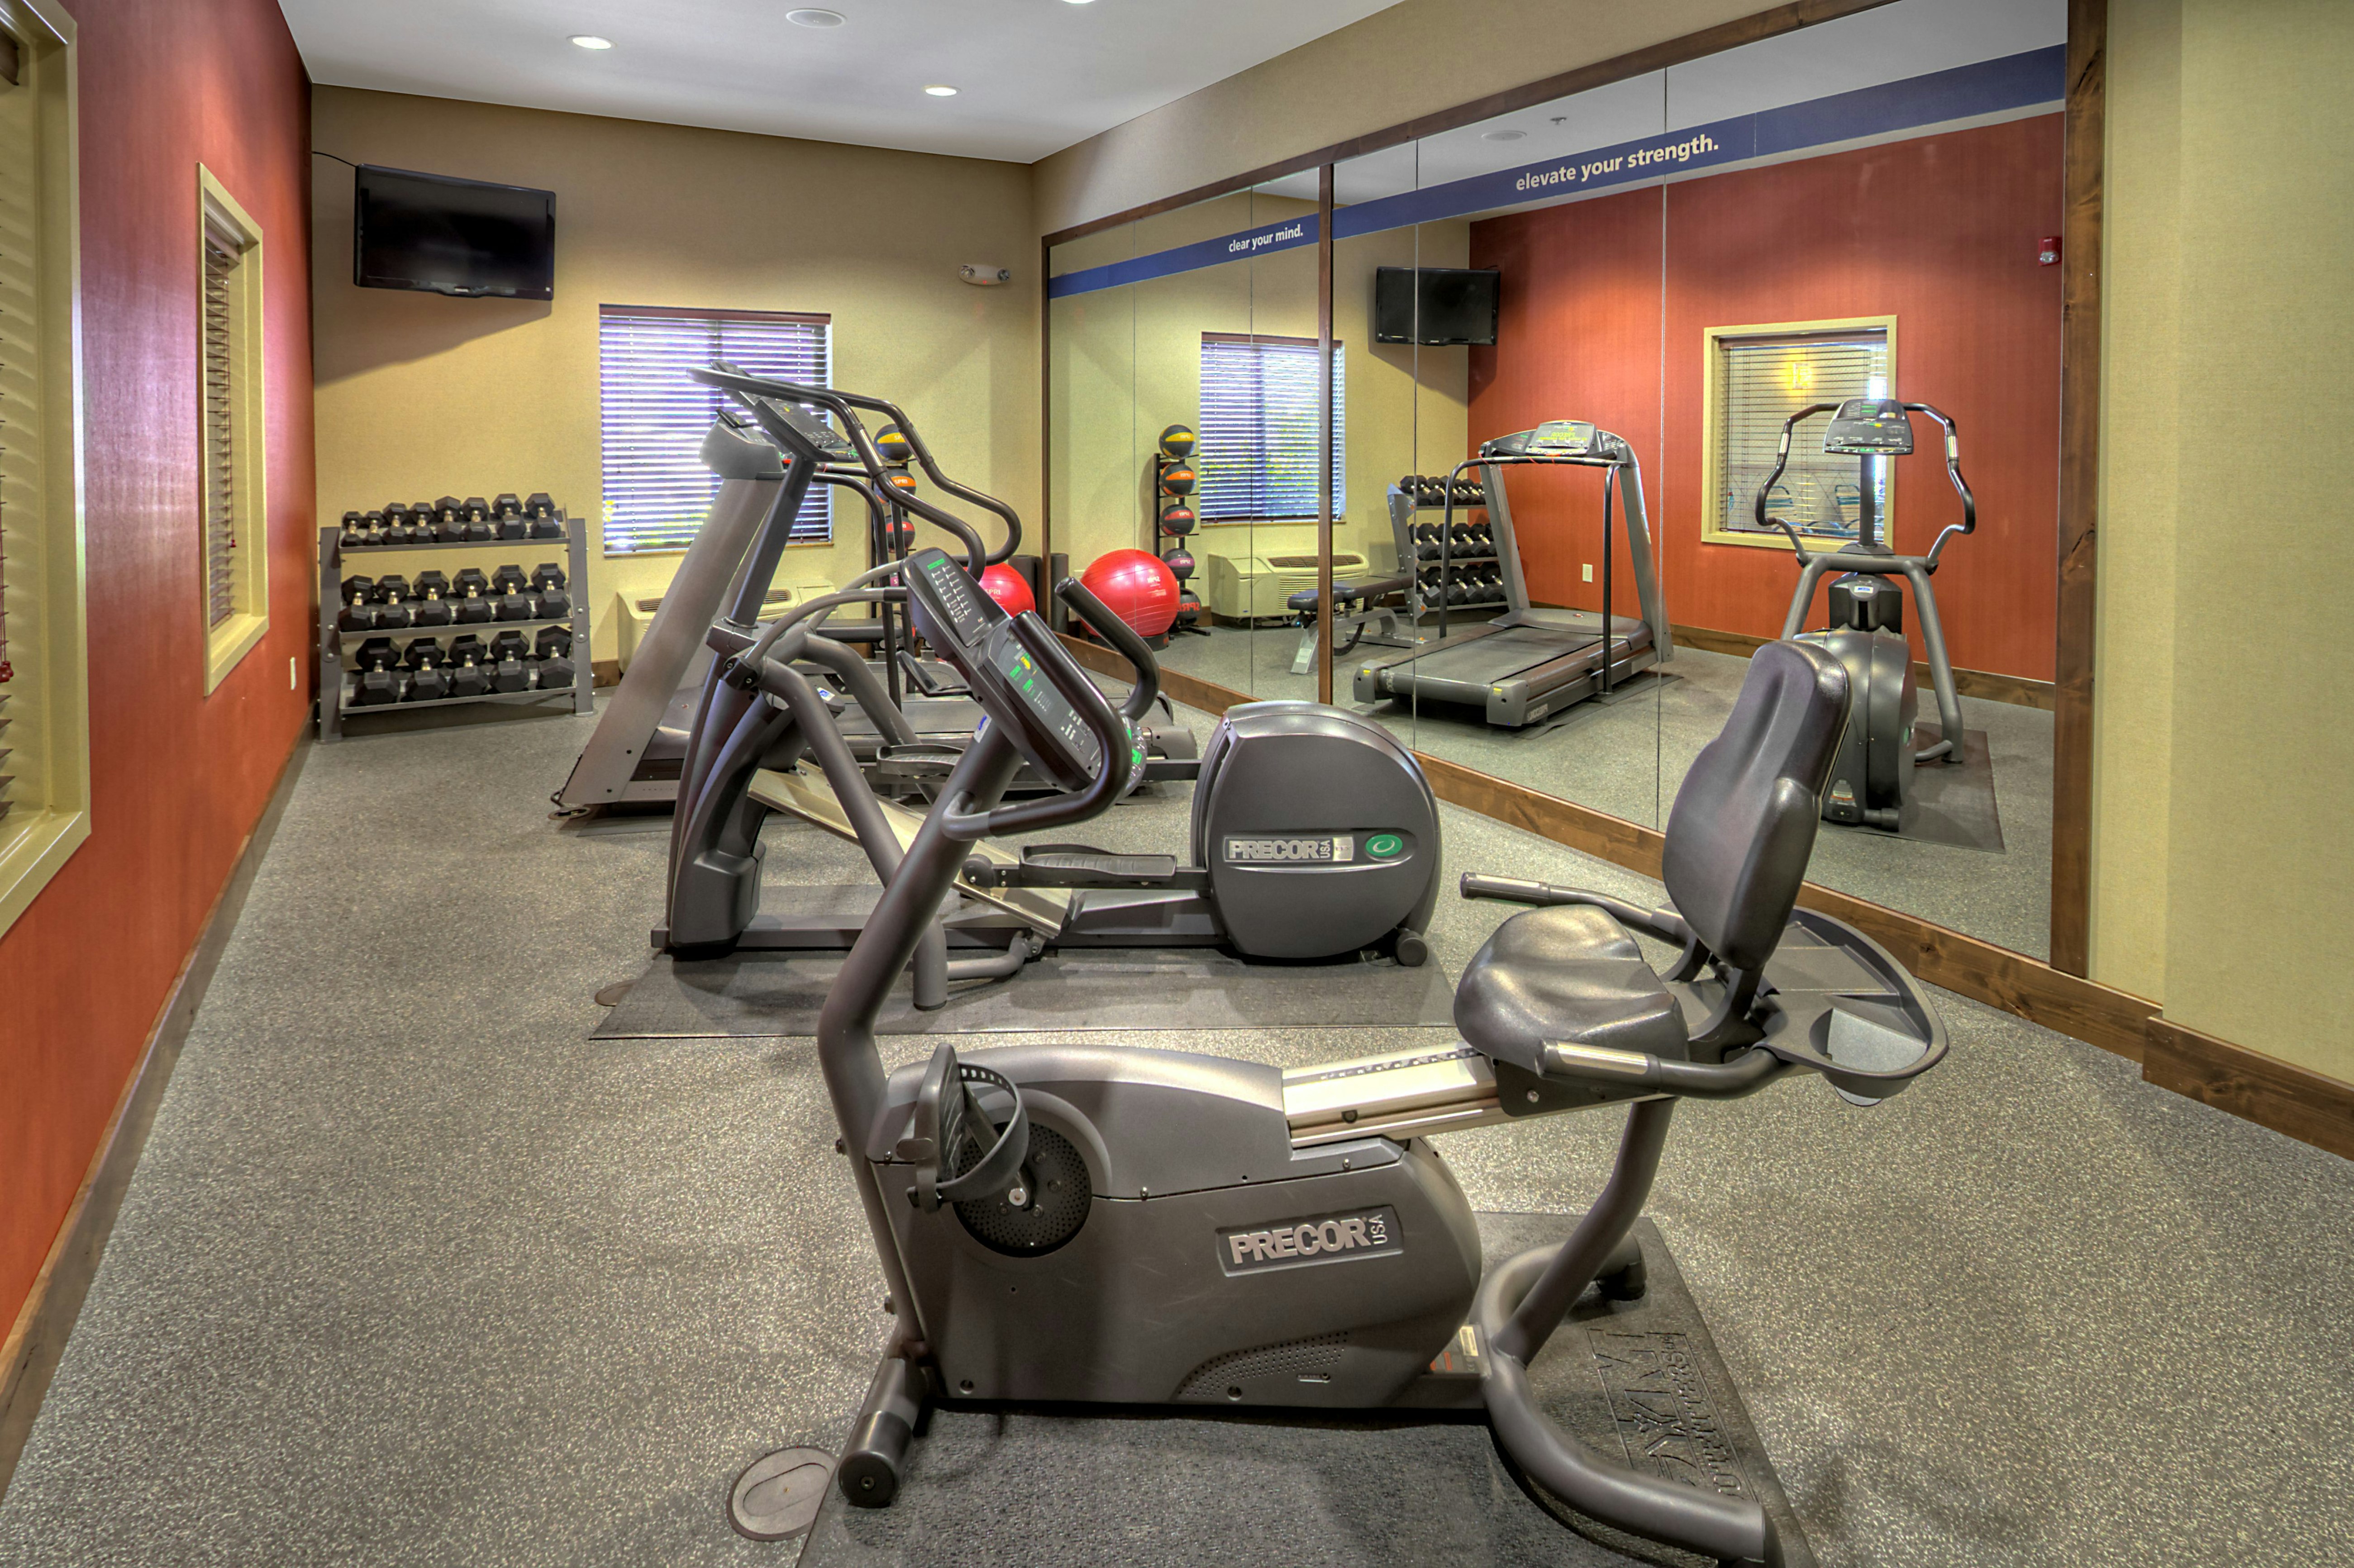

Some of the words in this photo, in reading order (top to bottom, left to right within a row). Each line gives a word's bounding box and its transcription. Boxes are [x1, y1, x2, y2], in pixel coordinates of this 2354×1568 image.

[1515, 166, 1576, 191] elevate
[1581, 155, 1623, 182] your
[1628, 133, 1719, 168] strength.
[1229, 239, 1250, 253] clear
[1252, 233, 1273, 250] your
[1275, 223, 1303, 242] mind.
[1229, 840, 1320, 859] PRECOR
[1320, 840, 1330, 858] USA
[1229, 1218, 1371, 1264] PRECOR
[1368, 1214, 1388, 1244] USA
[1662, 1350, 1744, 1498] UTFITTERS
